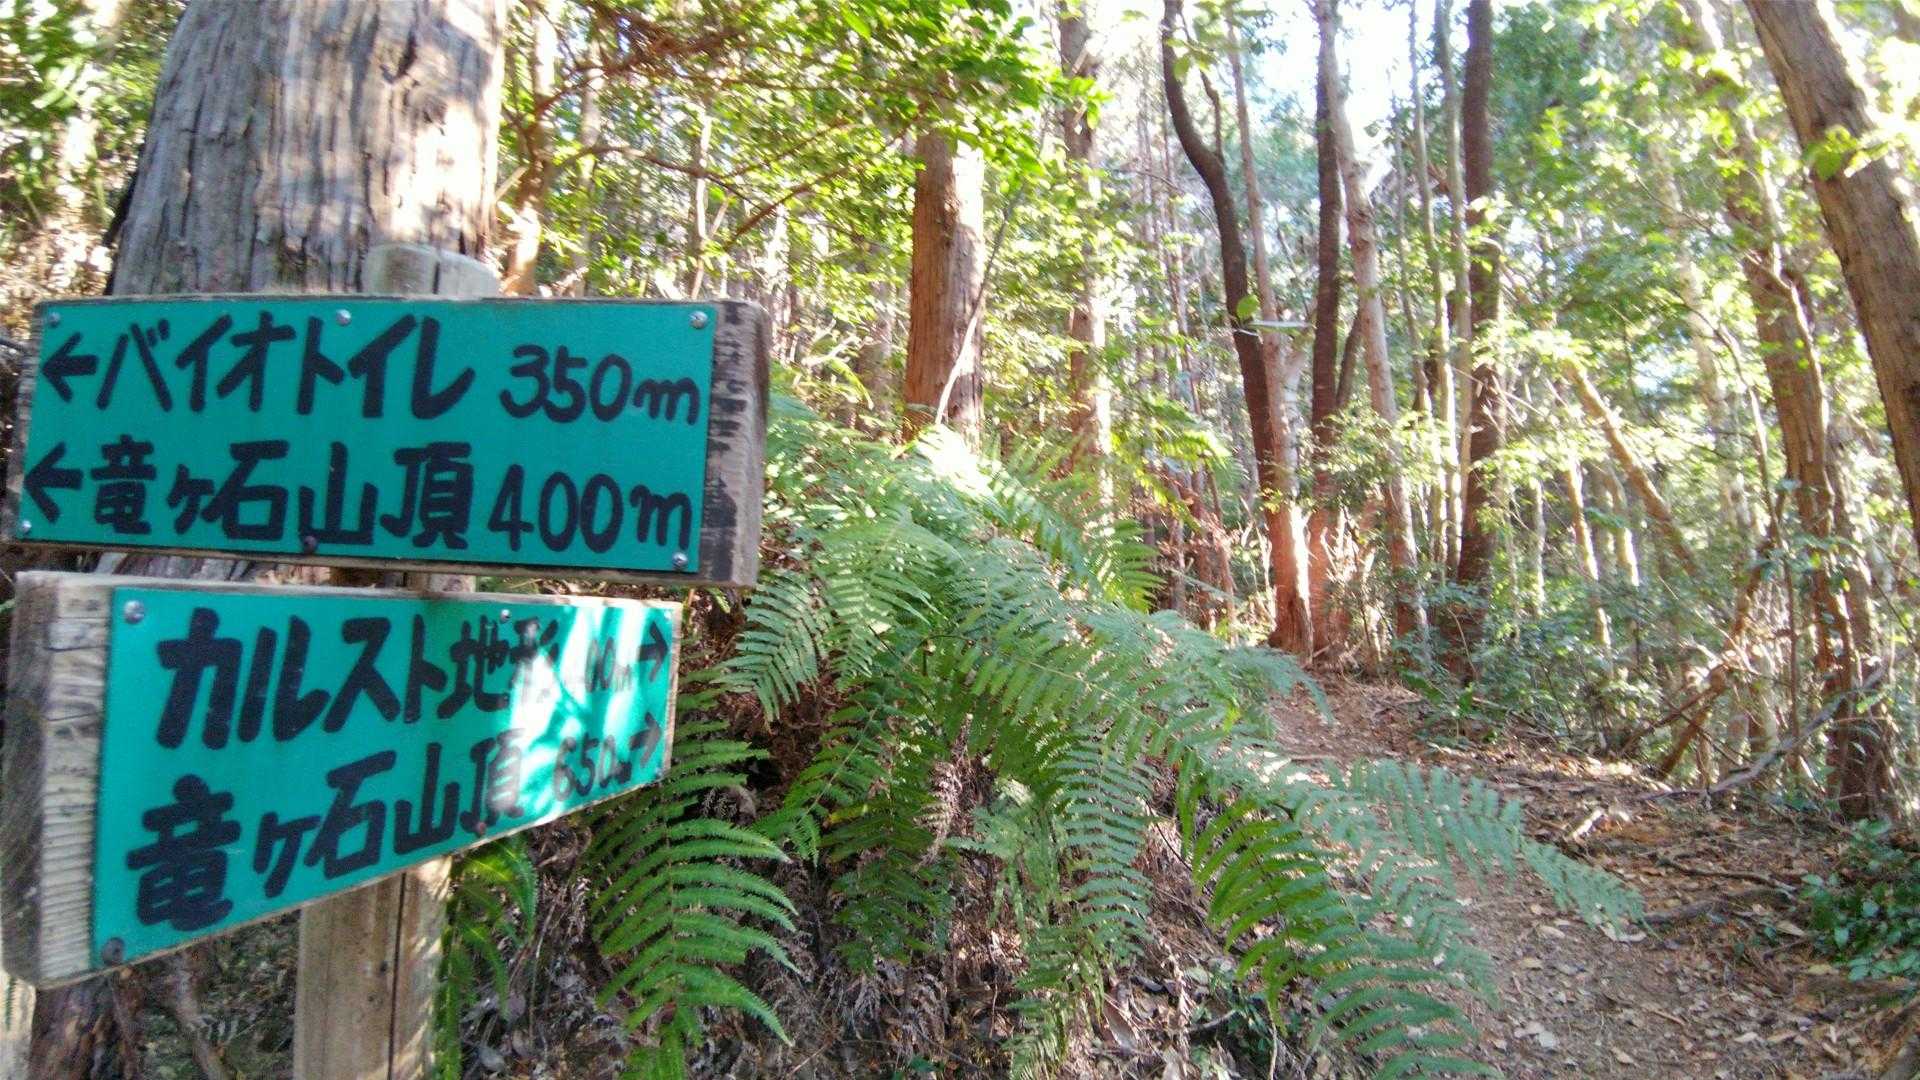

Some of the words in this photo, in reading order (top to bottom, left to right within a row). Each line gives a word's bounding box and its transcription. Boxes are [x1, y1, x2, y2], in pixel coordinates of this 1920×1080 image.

[97, 311, 475, 420] バイオトイレ
[499, 344, 699, 425] 350m
[487, 464, 694, 553] 400m
